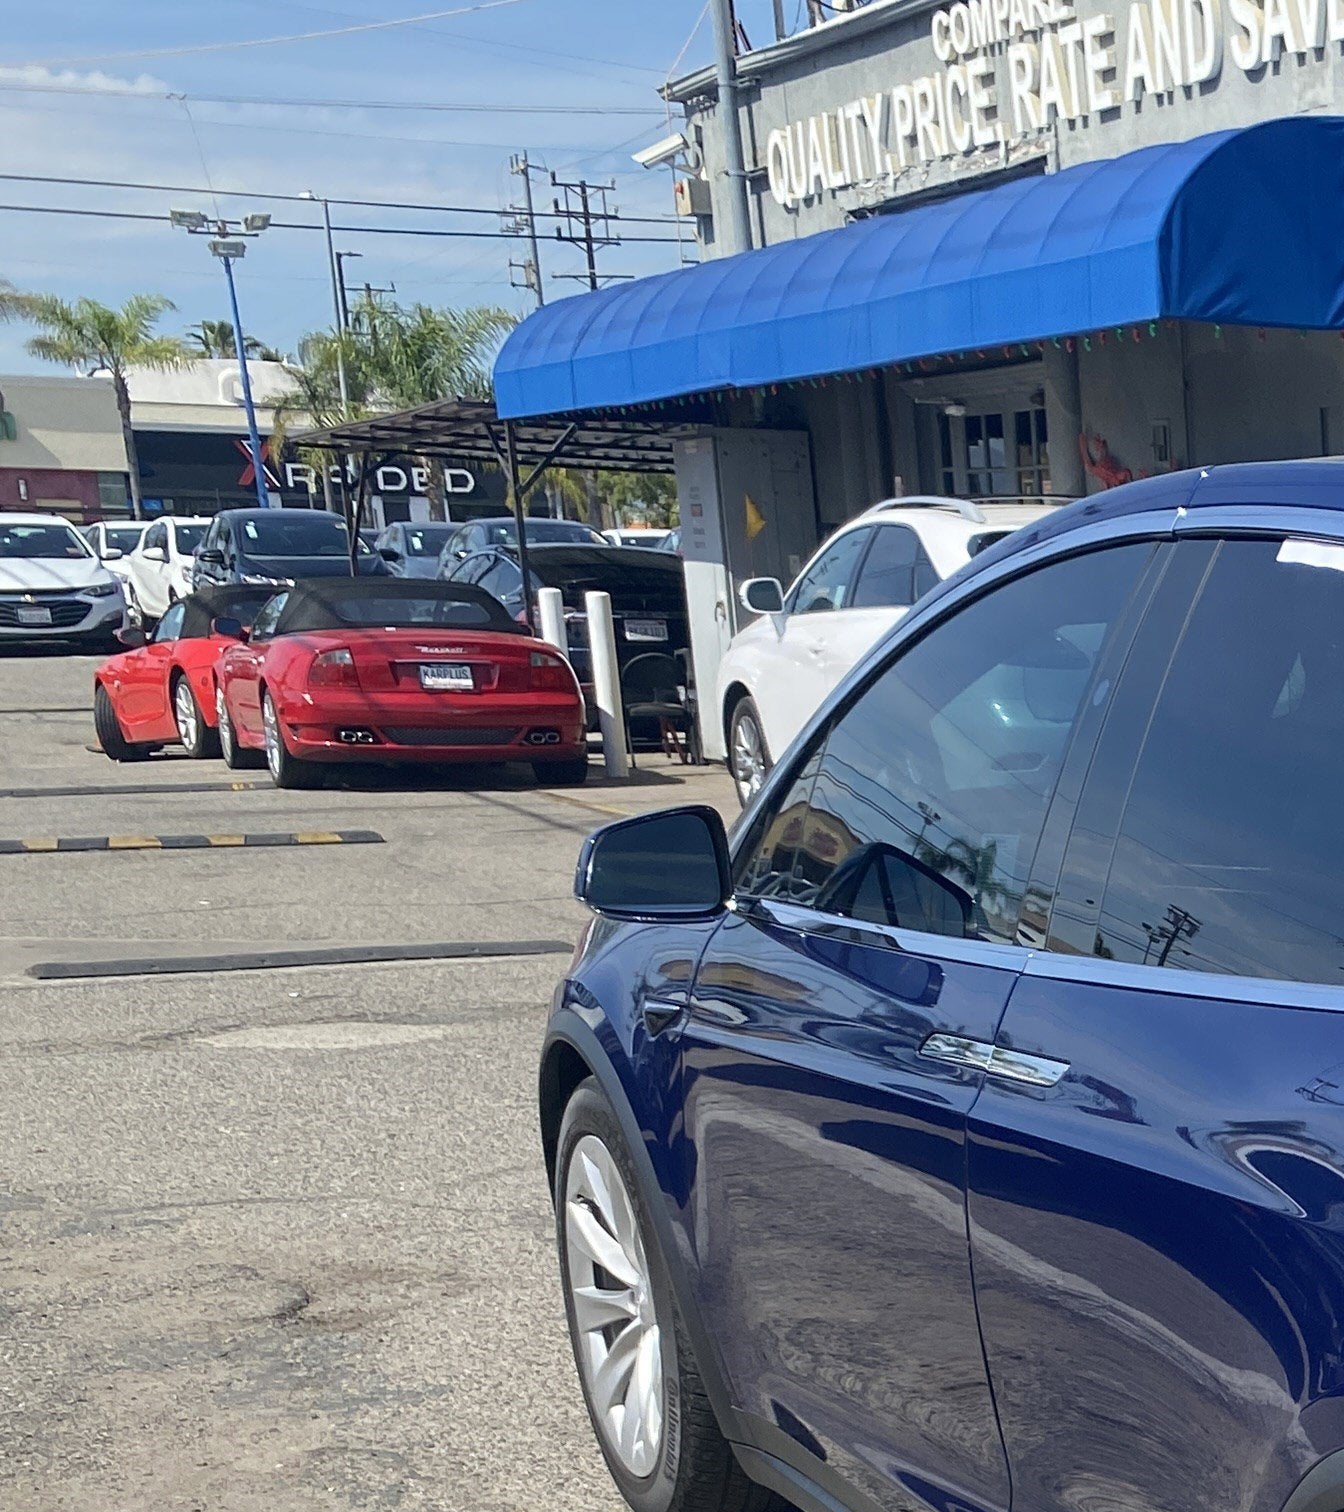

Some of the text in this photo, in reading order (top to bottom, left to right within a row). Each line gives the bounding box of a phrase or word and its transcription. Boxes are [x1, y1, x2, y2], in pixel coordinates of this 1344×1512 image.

[767, 92, 898, 207] QUALITY,
[892, 56, 1010, 166] PRICE,
[1008, 13, 1120, 133] RATE
[1124, 0, 1222, 101] AND
